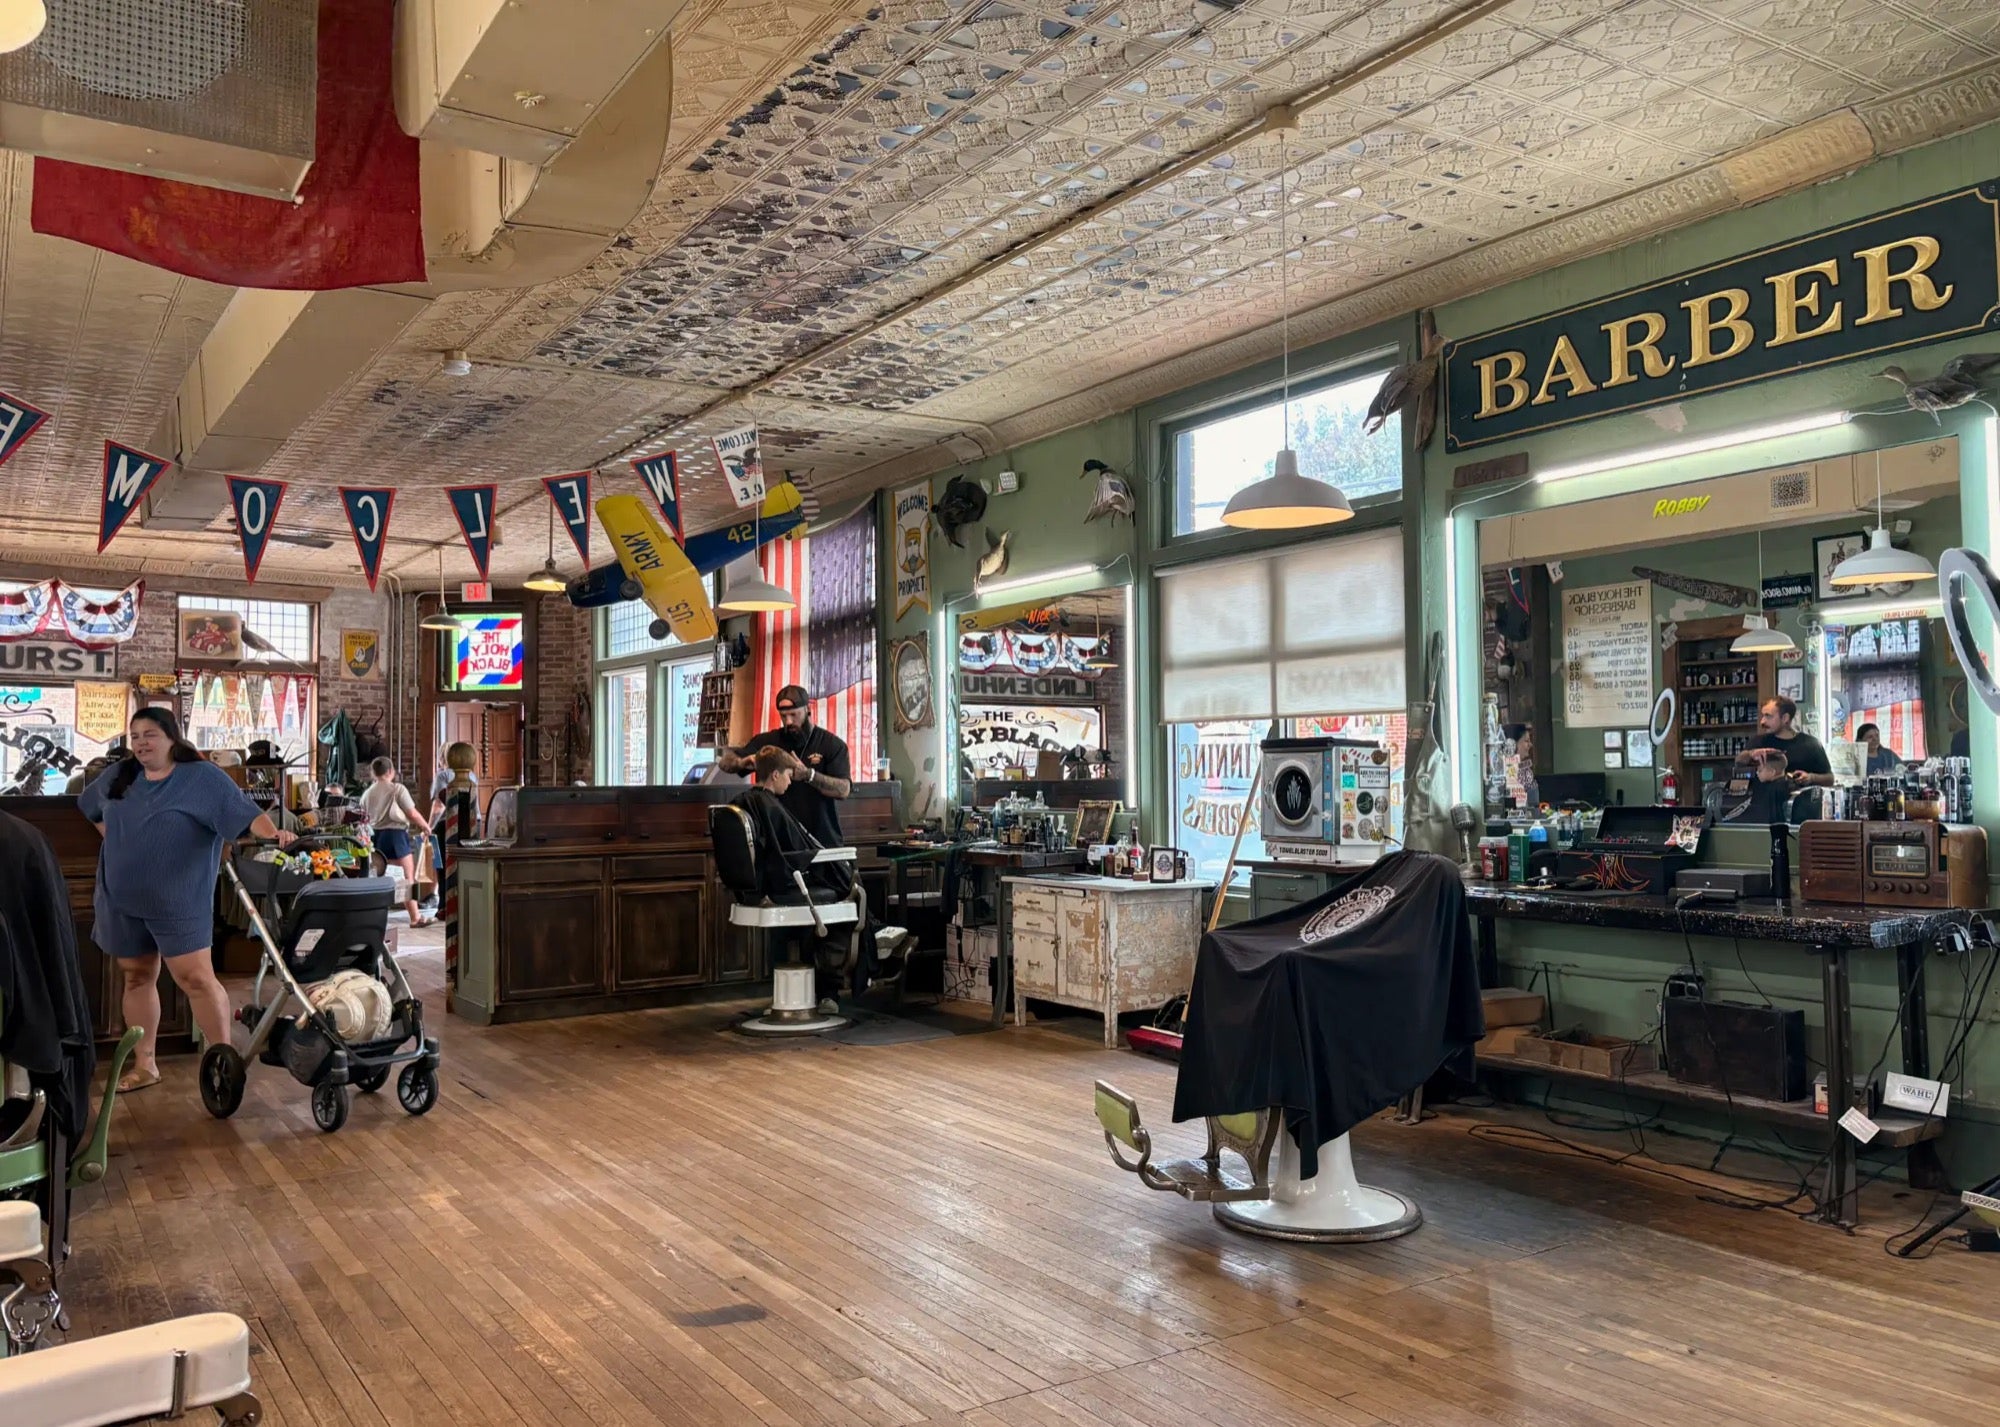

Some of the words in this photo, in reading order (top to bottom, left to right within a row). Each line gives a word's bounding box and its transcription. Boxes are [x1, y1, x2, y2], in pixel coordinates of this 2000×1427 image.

[1472, 235, 1953, 420] BARBER
[897, 494, 928, 519] WELCOME
[1653, 495, 1711, 519] ROBBY
[727, 524, 756, 544] 42
[620, 530, 663, 573] ARMY
[898, 575, 928, 597] PROPHET.
[180, 673, 196, 693] NEW
[182, 694, 194, 716] YORK
[982, 711, 1014, 722] THE
[990, 726, 1068, 752] BLAC
[1902, 1086, 1932, 1099] WAHL
